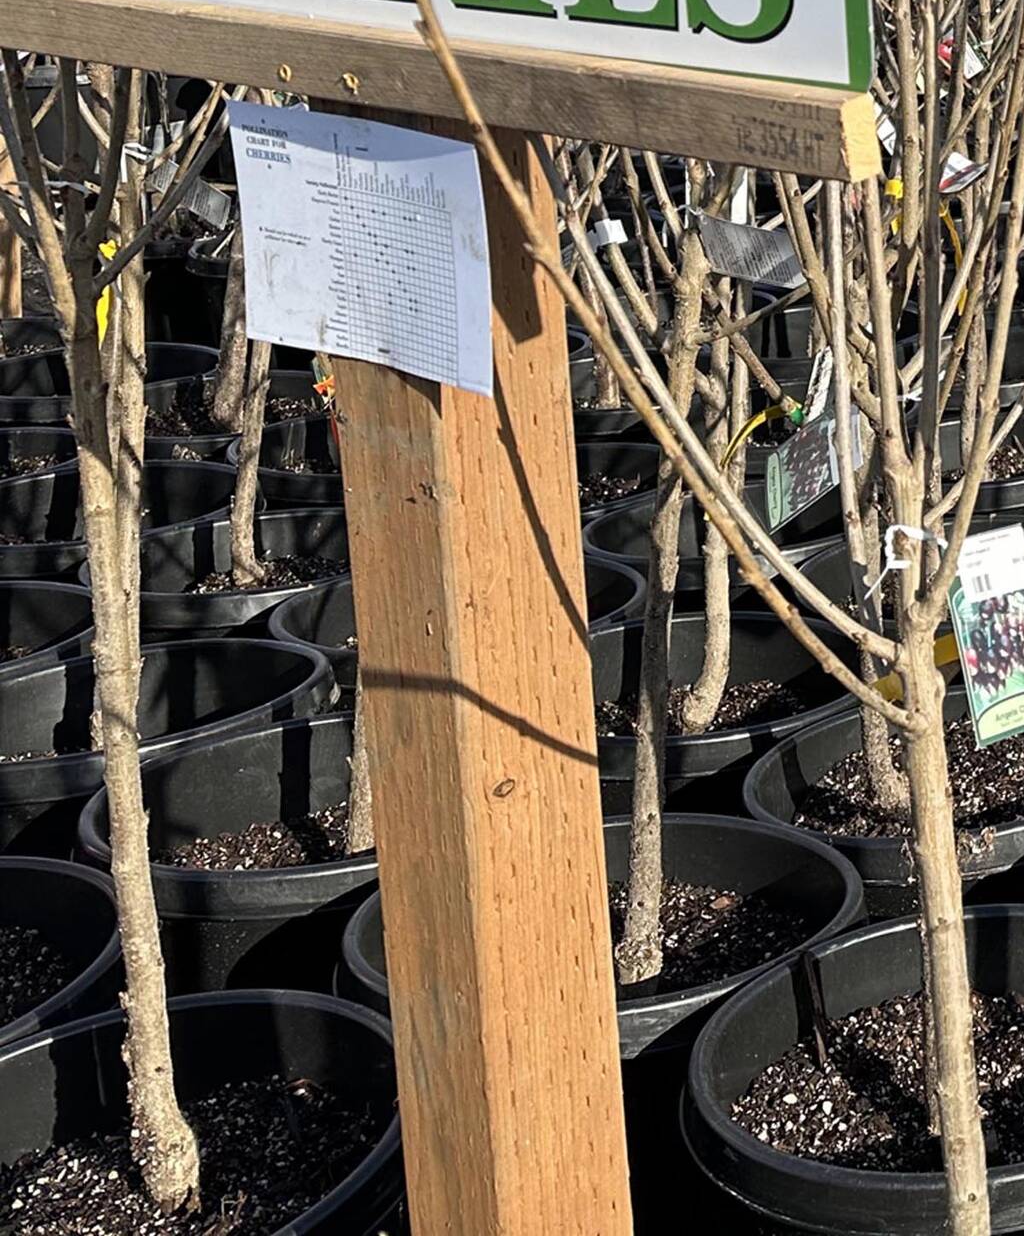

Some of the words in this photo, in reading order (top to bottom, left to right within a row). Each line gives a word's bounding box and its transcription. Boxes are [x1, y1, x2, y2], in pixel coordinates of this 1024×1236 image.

[241, 123, 289, 140] POLLINATION
[246, 135, 270, 147] CHART
[245, 147, 292, 164] CHERRIES
